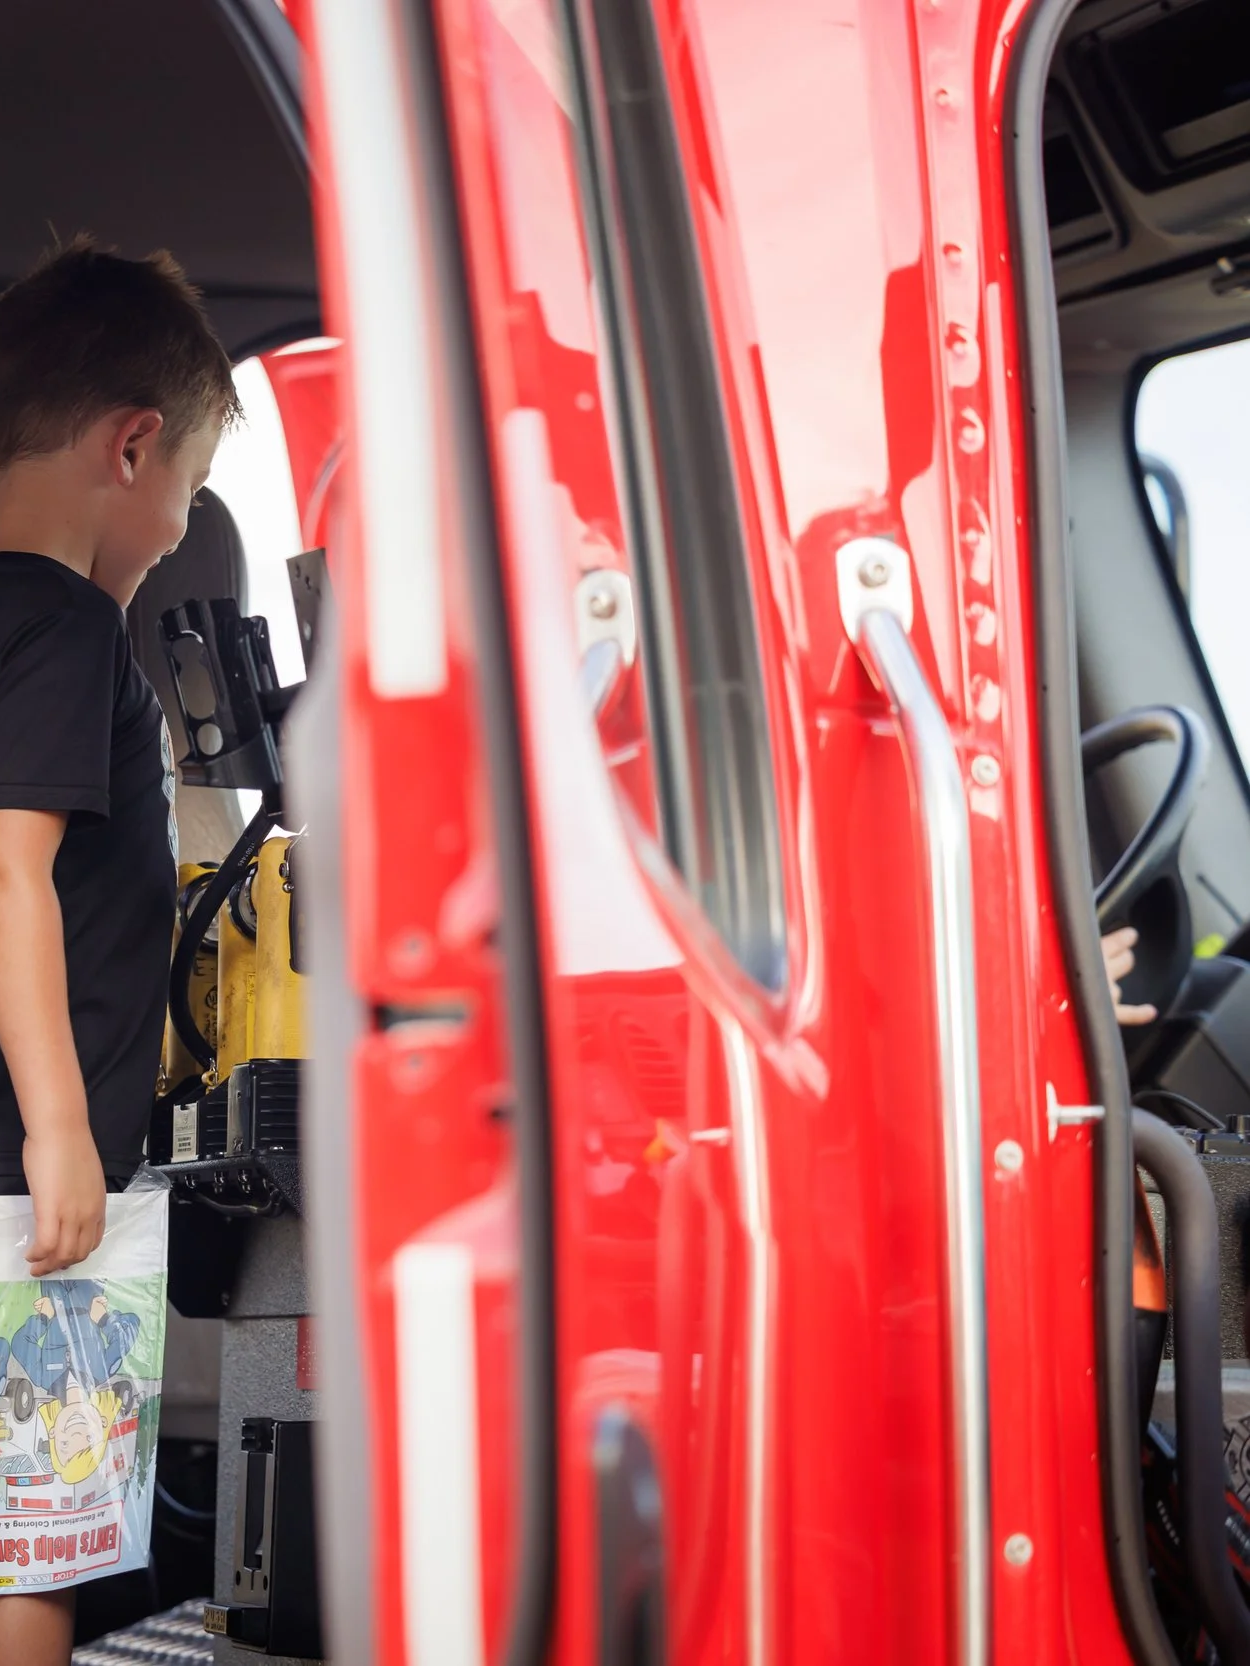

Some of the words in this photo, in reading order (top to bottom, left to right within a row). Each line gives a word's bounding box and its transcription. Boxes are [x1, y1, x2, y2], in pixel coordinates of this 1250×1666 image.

[52, 1514, 95, 1527] Educational
[34, 1534, 77, 1564] Help
[80, 1522, 117, 1556] EMTs
[54, 1570, 75, 1580] STOP
